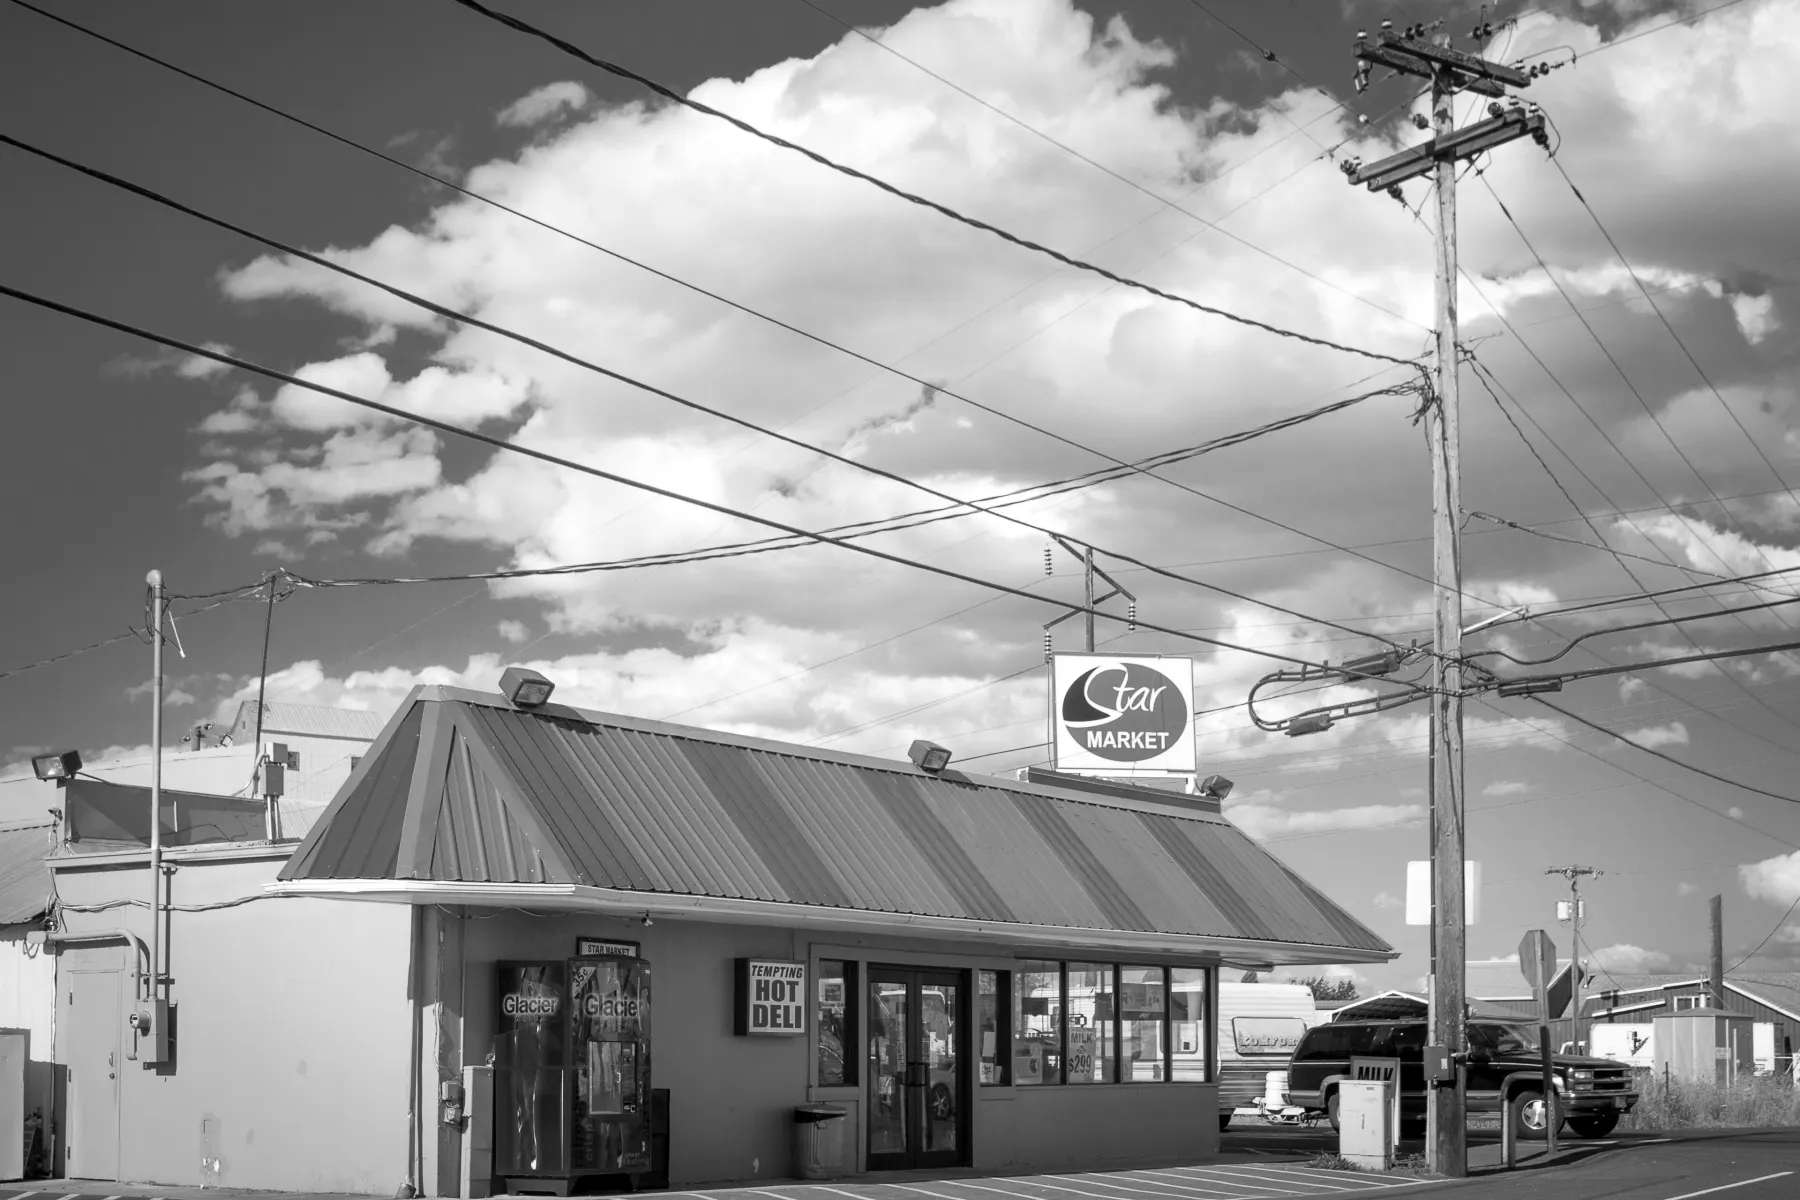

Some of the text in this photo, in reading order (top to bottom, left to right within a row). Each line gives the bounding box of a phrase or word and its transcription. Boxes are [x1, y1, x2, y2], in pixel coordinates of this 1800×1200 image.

[1064, 662, 1167, 728] Star
[1087, 731, 1169, 749] MARKET
[587, 944, 604, 954] STAR
[751, 965, 803, 979] TEMPTING
[755, 979, 799, 1003] HOT
[504, 995, 557, 1014] Glacier
[585, 994, 638, 1017] Glacie
[752, 1004, 802, 1029] DELI
[1071, 1033, 1092, 1043] MILK
[1240, 1036, 1299, 1047] COMFOR
